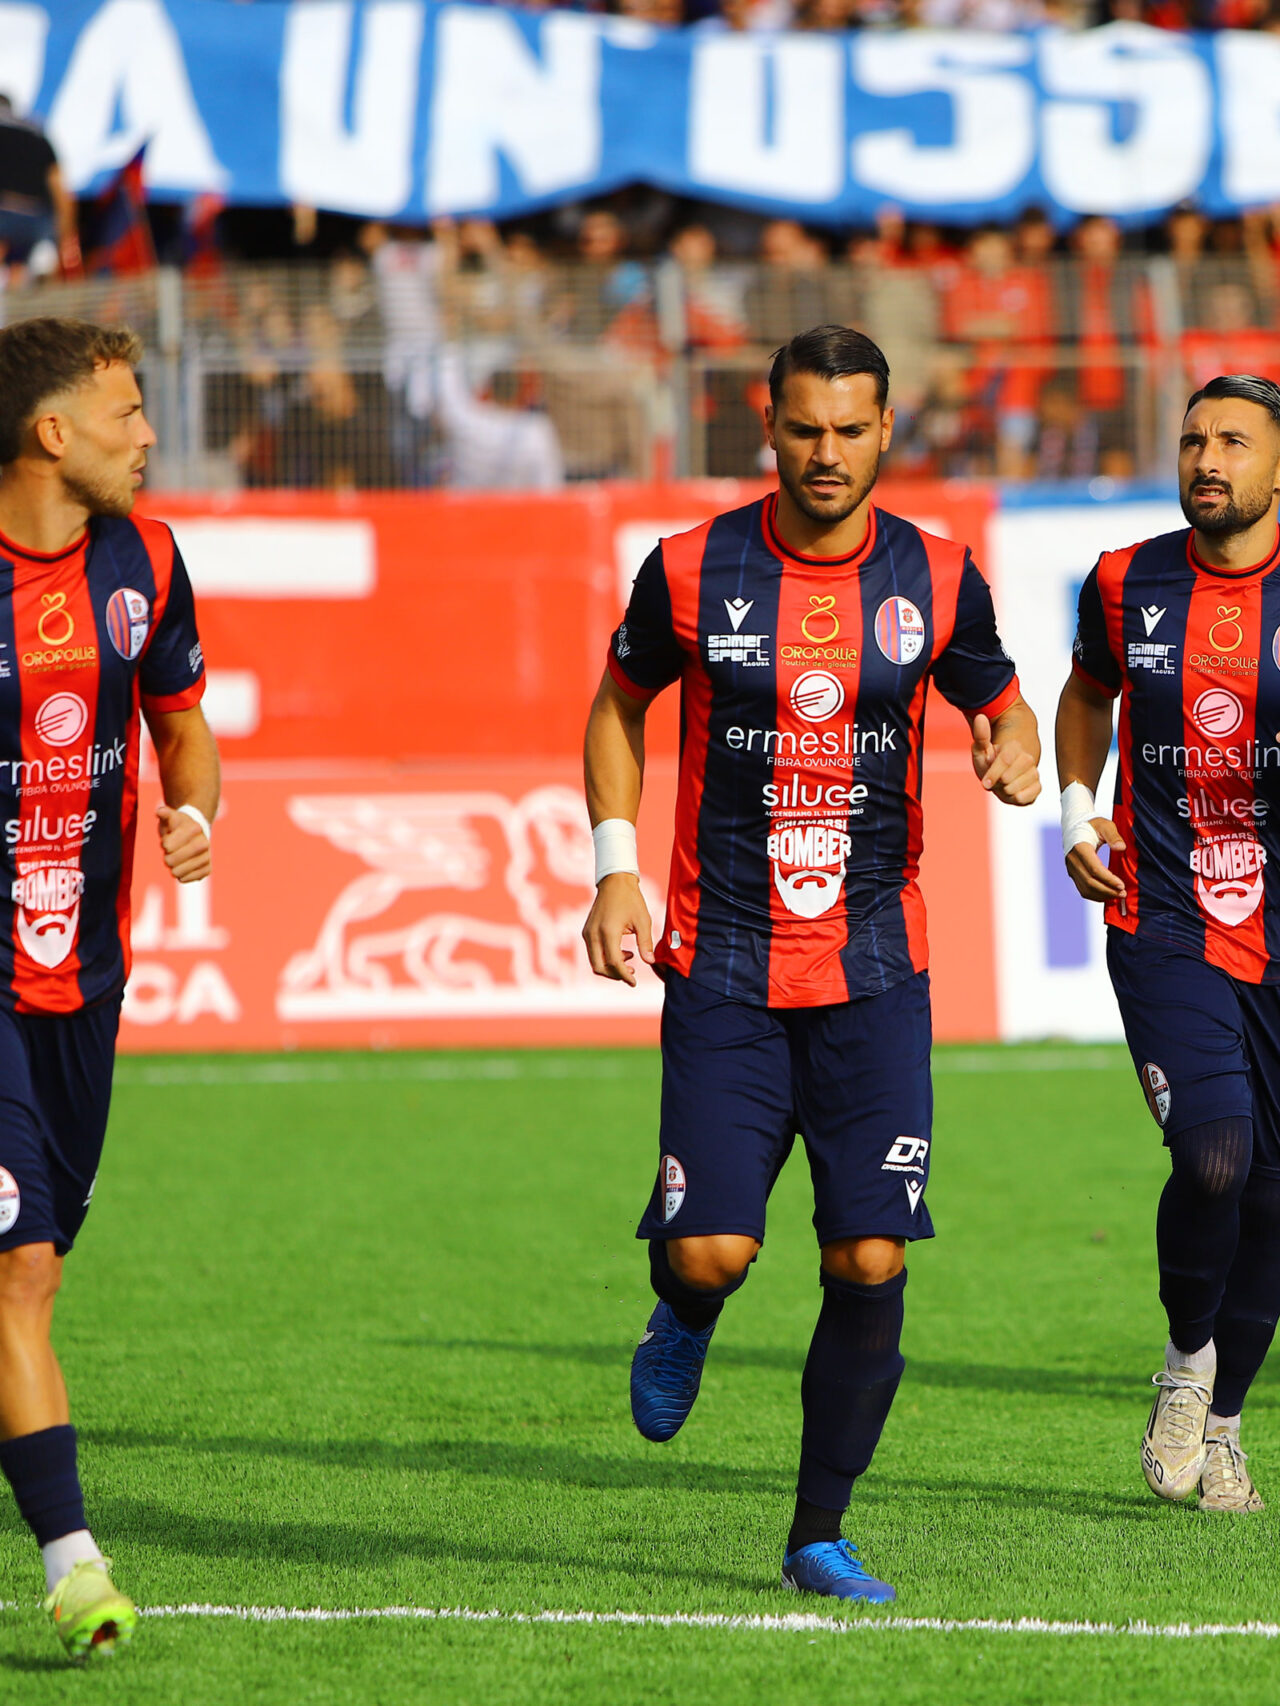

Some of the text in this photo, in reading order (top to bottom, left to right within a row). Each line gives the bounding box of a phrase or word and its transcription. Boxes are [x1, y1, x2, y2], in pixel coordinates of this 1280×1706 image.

[280, 3, 602, 217] UN
[725, 721, 897, 756] ermeslink
[766, 756, 861, 769] FIBRA OVUNQUE
[1177, 768, 1208, 779] FIBRA
[761, 772, 869, 808] siluce
[1176, 788, 1270, 819] siluce
[5, 804, 98, 844] siluce
[764, 810, 812, 818] ACCENDIAMO
[822, 808, 864, 817] TERRITORIO
[775, 818, 848, 832] CHIAMARSI
[766, 826, 852, 868] BOMBER
[1189, 840, 1268, 880] BOMBER
